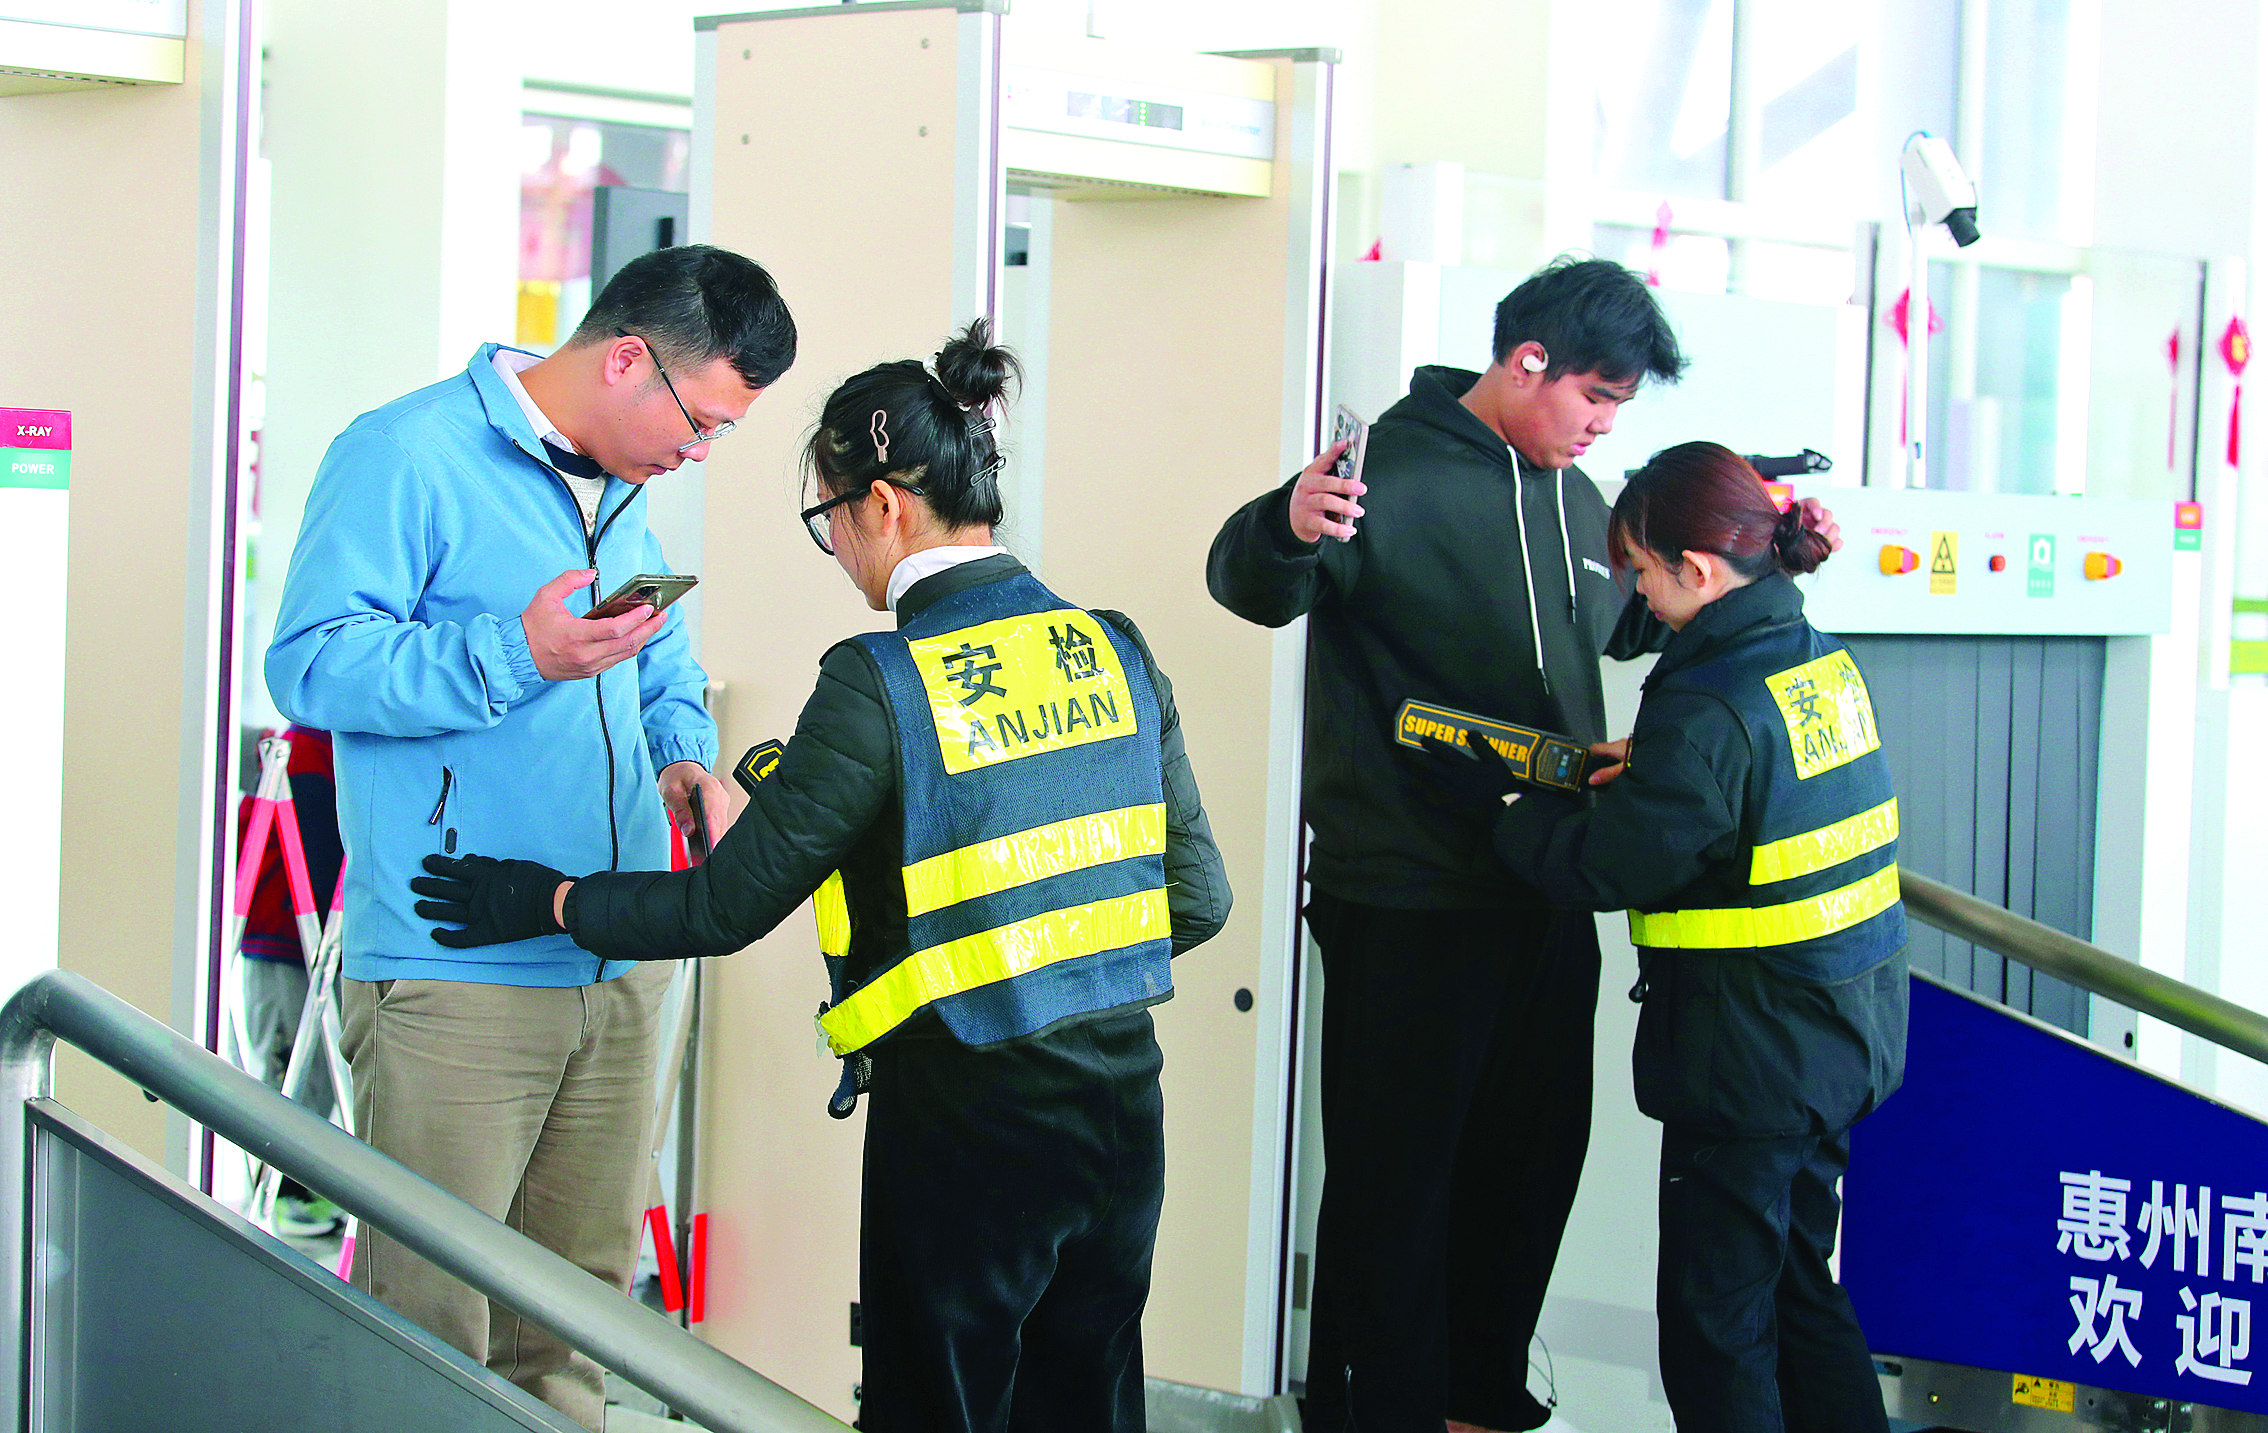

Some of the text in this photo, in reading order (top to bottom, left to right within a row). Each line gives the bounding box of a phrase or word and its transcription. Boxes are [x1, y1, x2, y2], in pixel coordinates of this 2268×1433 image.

[16, 425, 53, 437] X-RAY
[11, 462, 55, 475] POWER
[942, 624, 1104, 708] 安检
[968, 690, 1119, 757] ANJIAN
[1404, 715, 1529, 762] SUPER SNNER
[2056, 1169, 2268, 1284] 惠州南
[2067, 1273, 2252, 1386] 欢迎
